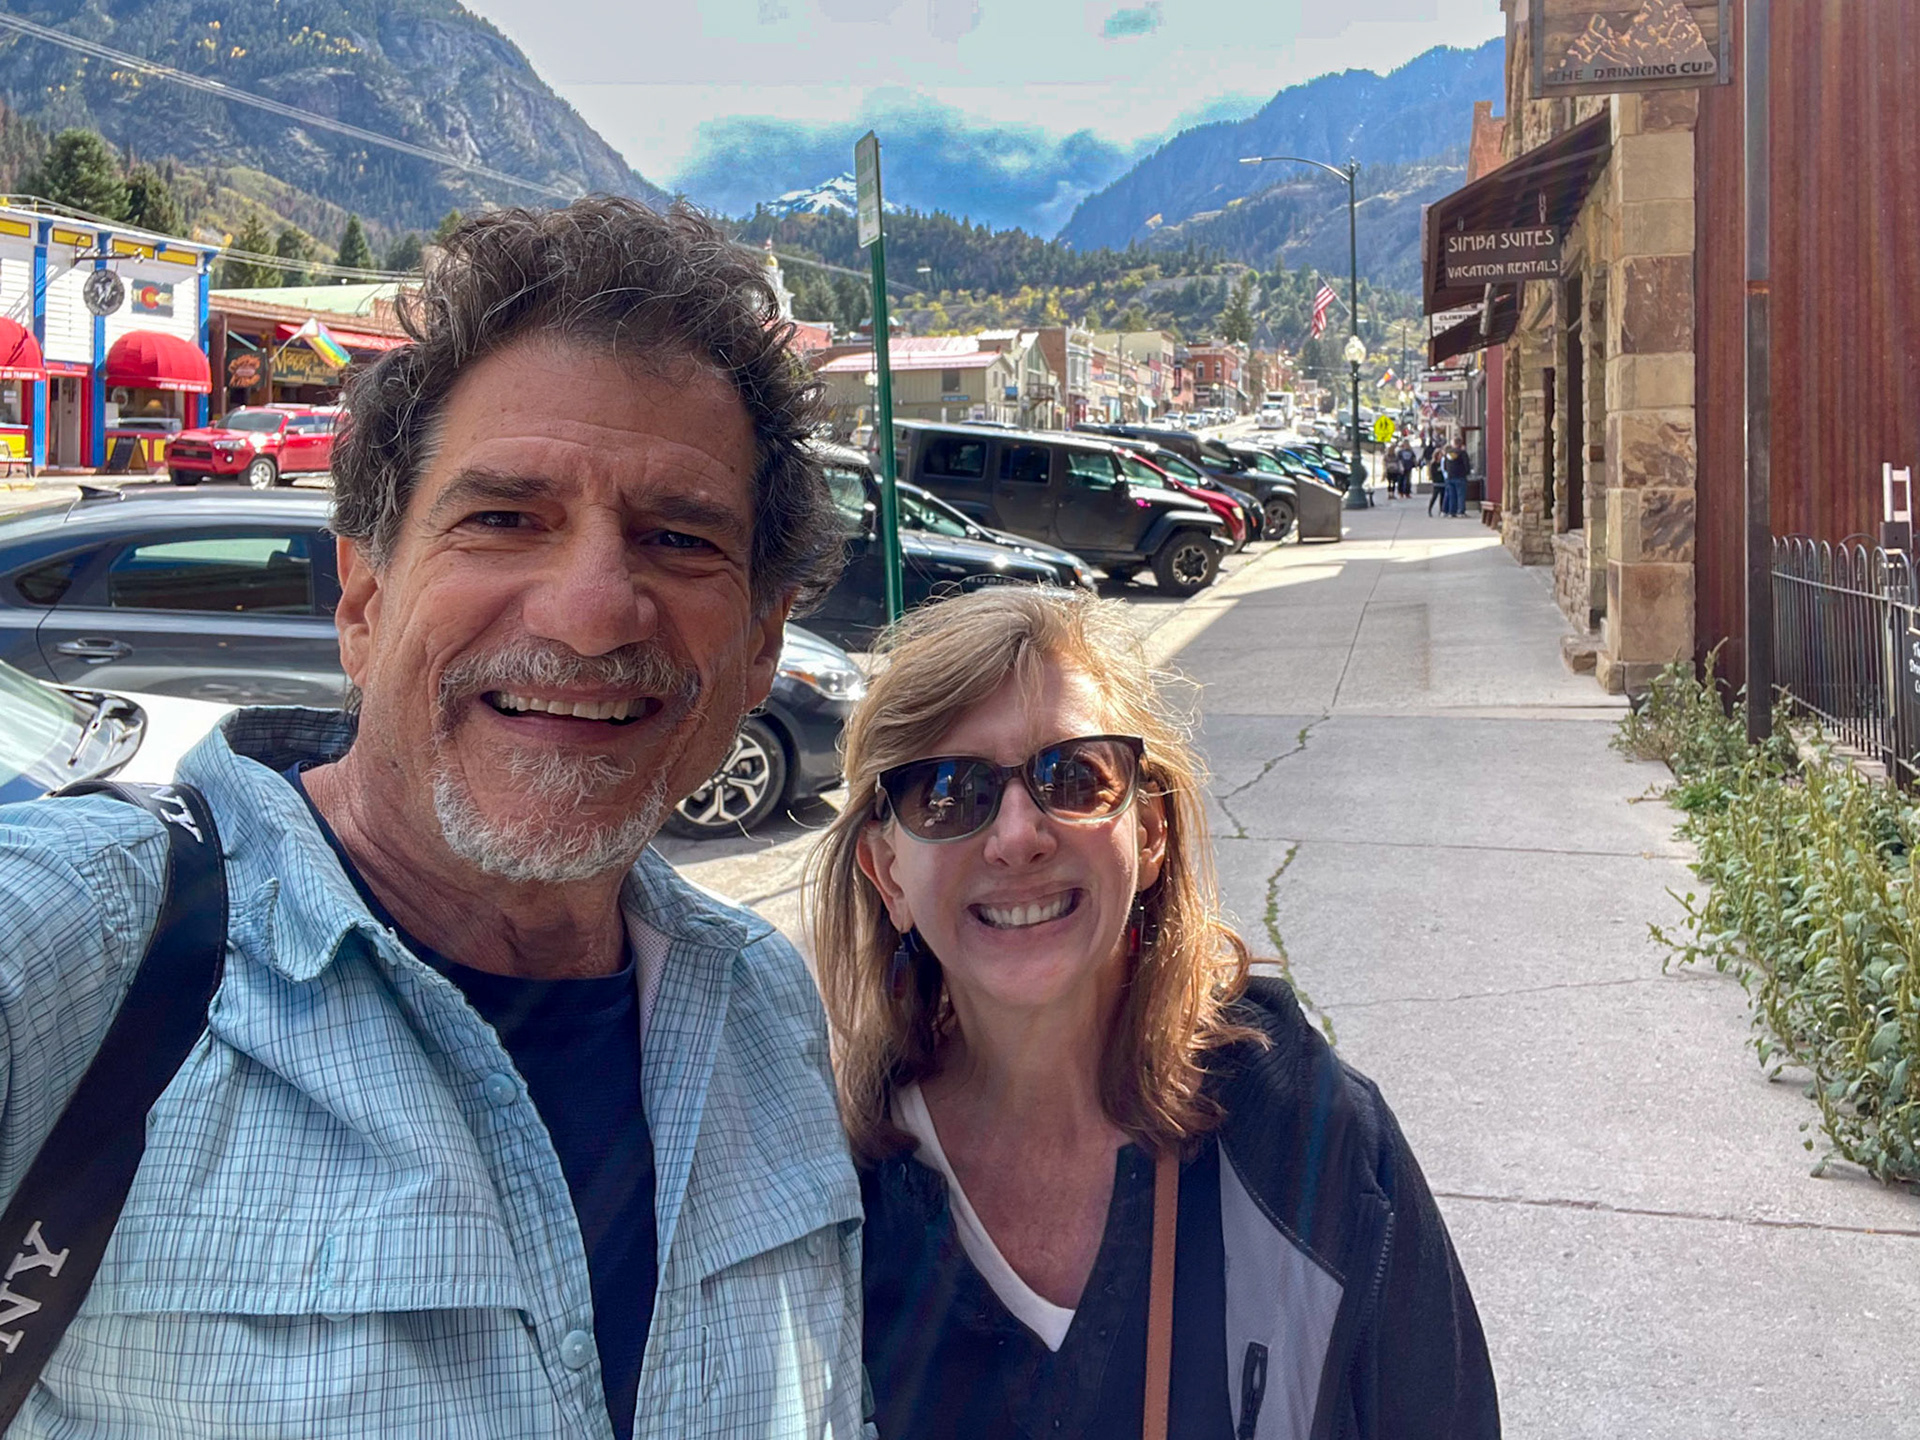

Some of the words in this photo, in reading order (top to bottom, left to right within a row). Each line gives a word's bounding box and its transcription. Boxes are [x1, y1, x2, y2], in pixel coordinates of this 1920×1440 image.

[1552, 69, 1583, 81] THE
[1594, 63, 1677, 79] DRINKING
[1680, 61, 1714, 74] CUP
[1447, 234, 1496, 253] SIMBA
[1499, 229, 1555, 249] SUITES
[1447, 263, 1504, 279] VACATION
[1507, 259, 1559, 275] RENTALS
[132, 782, 204, 844] NY
[0, 1220, 70, 1354] NY
